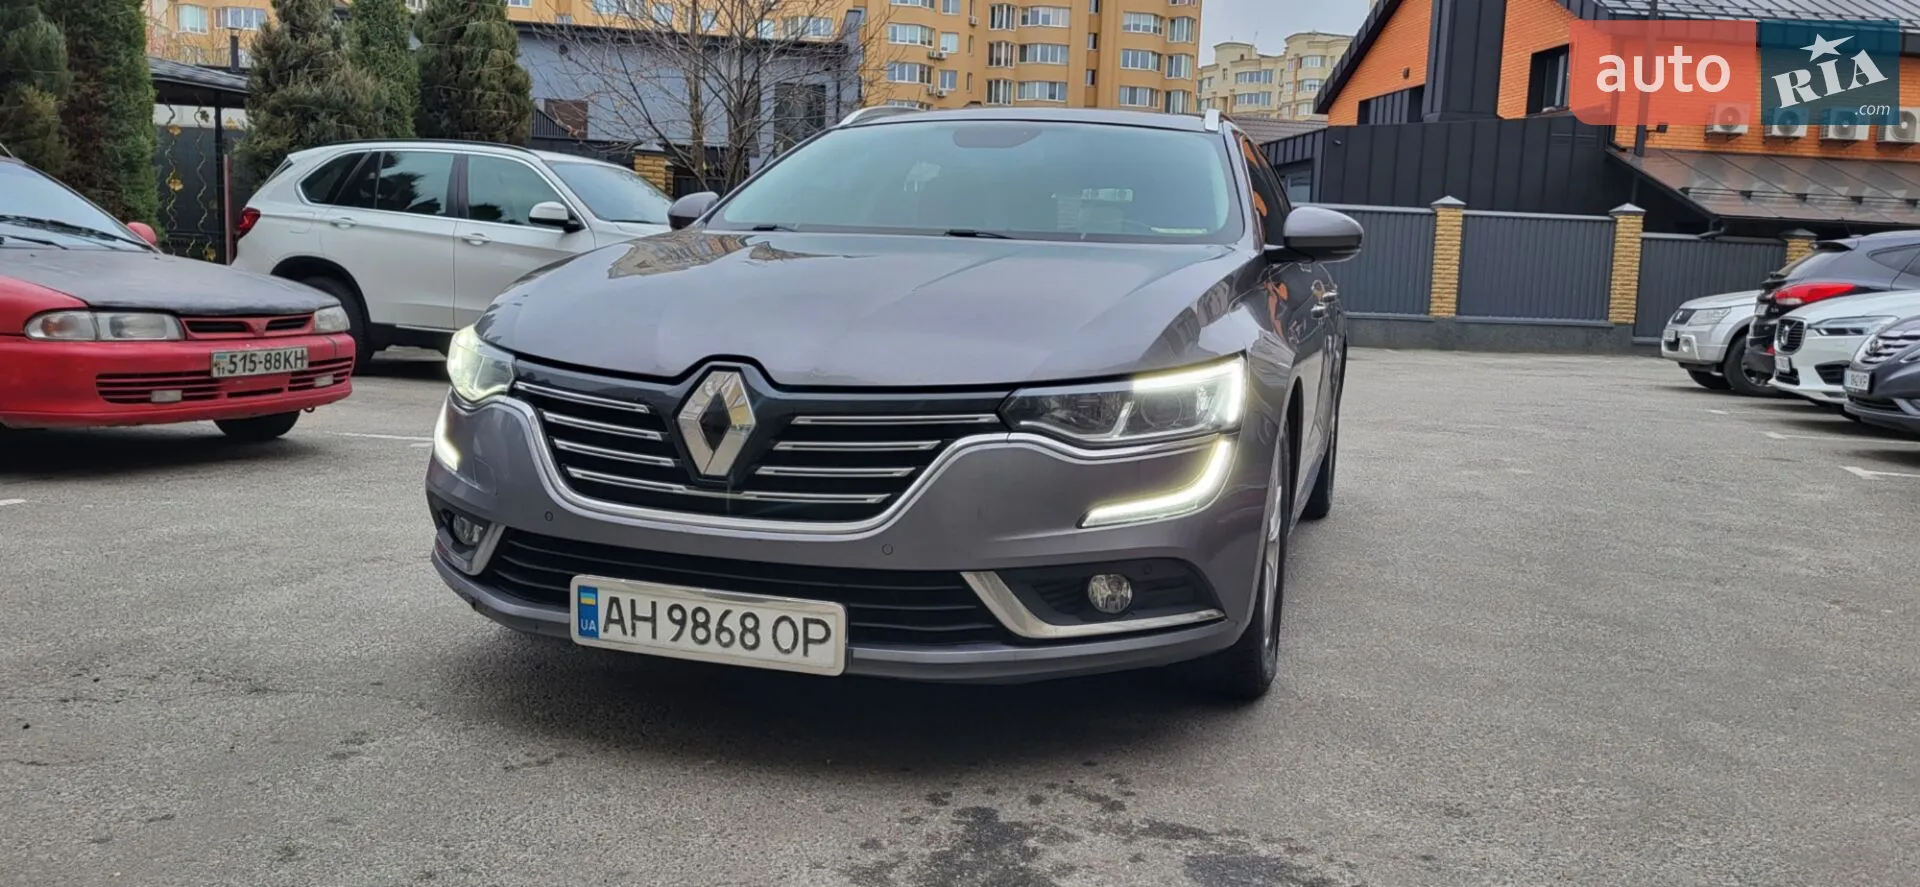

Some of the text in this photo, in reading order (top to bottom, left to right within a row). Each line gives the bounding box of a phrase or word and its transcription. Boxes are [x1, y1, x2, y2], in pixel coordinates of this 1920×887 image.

[227, 349, 304, 374] 515-88KH
[580, 618, 597, 632] UA
[602, 596, 832, 657] AH 9868 OP
